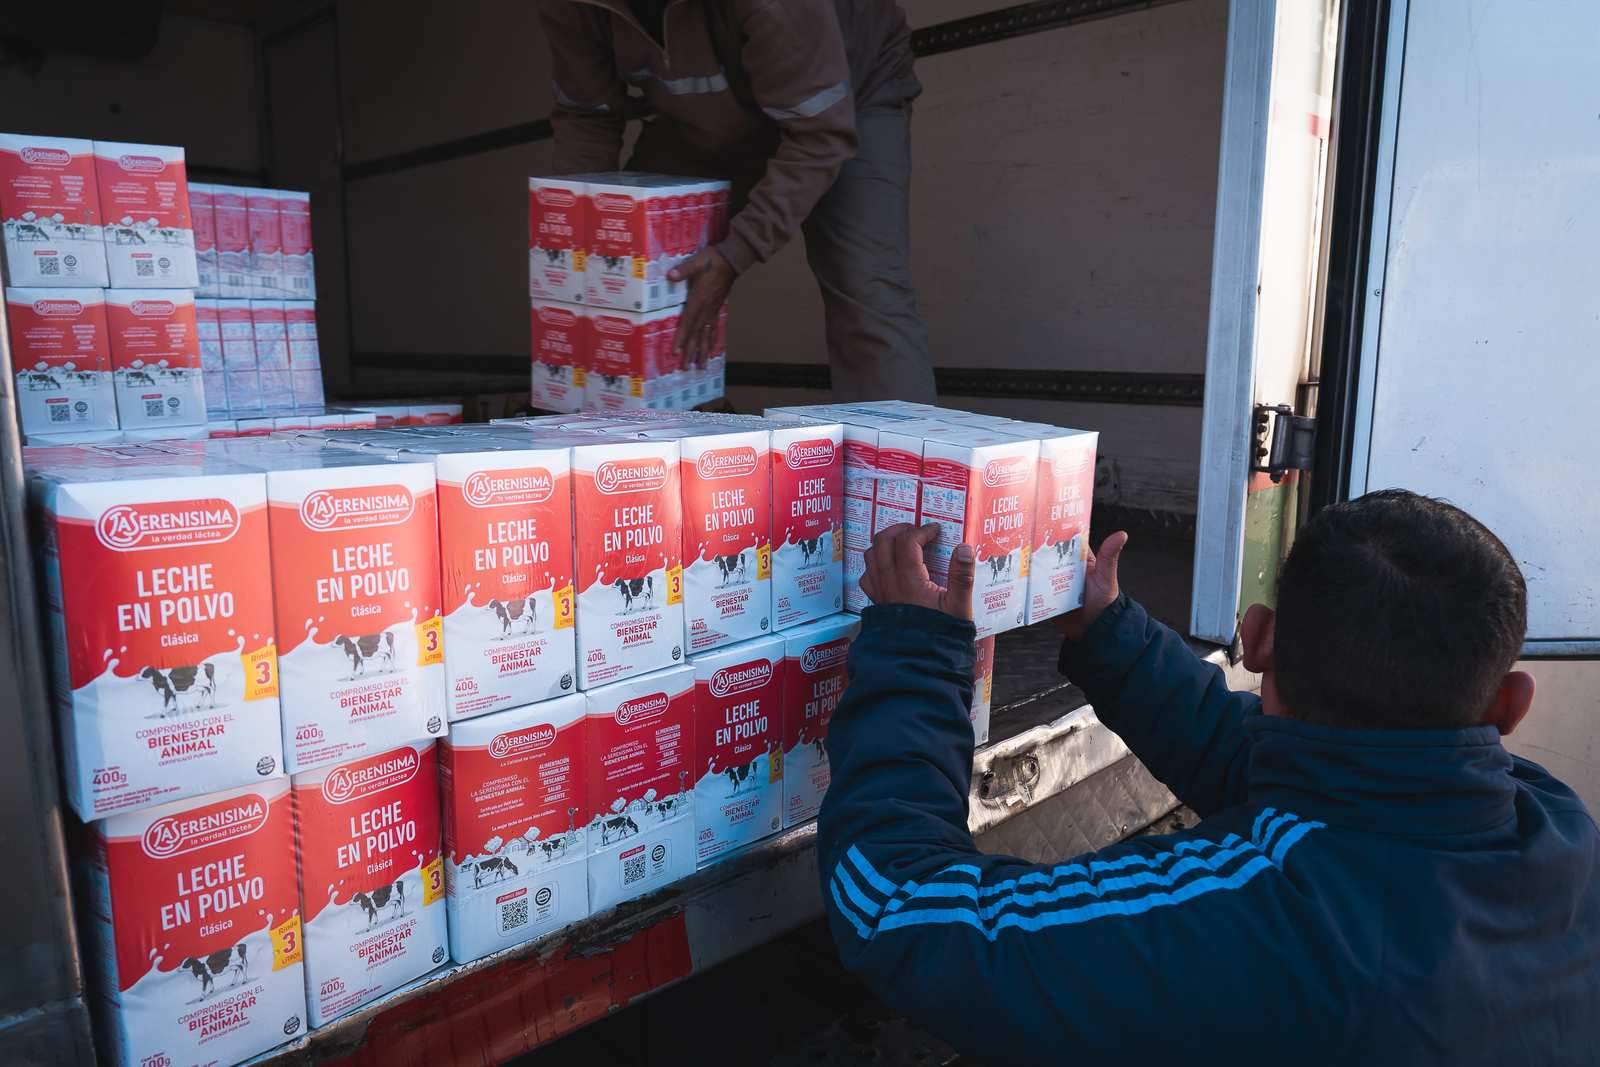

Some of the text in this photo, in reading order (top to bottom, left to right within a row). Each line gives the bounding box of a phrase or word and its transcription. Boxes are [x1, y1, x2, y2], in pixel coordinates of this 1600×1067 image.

[798, 478, 826, 497] LECHE
[712, 488, 745, 509] LECHE
[791, 495, 832, 517] EN POLVO
[993, 496, 1019, 514] LECHE
[614, 504, 653, 528] LECHE
[705, 507, 755, 532] EN POLVO
[984, 512, 1024, 534] EN POLVO
[1051, 505, 1061, 521] EN
[161, 531, 192, 542] verdad
[487, 519, 537, 544] LECHE
[604, 525, 663, 553] EN POLVO
[723, 533, 739, 542] Clásica
[332, 543, 393, 573] LECHE
[475, 541, 549, 571] EN POLVO
[625, 554, 645, 564] Clásica
[761, 553, 768, 570] 3
[136, 563, 214, 598] LECHE
[316, 568, 409, 604] EN POLVO
[502, 573, 527, 584] Clásica
[672, 577, 680, 593] 3
[351, 604, 382, 617] Clásica
[561, 598, 570, 616] 3
[715, 594, 749, 608] BIENESTAR
[721, 604, 744, 615] ANIMAL
[117, 591, 234, 632] EN POLVO
[616, 621, 657, 637] BIENESTAR
[623, 632, 651, 645] ANIMAL
[160, 632, 199, 647] Clásica
[426, 630, 438, 652] 3
[483, 642, 526, 657] COMPROMISO
[527, 639, 540, 648] CON
[491, 646, 542, 665] BIENESTAR
[500, 658, 534, 673] ANIMAL
[587, 652, 606, 663] 400g
[255, 661, 271, 685] 3
[330, 683, 383, 700] COMPROMISO
[384, 679, 400, 690] CON
[455, 680, 478, 692] 400g
[814, 675, 842, 698] LECHE
[340, 687, 403, 709] BIENESTAR
[350, 699, 395, 718] ANIMAL
[725, 700, 760, 724] LECHE
[806, 703, 818, 719] EN
[135, 713, 235, 739] COMPROMISO CON EL
[296, 728, 324, 741] 400g
[716, 716, 768, 746] EN POLVO
[148, 724, 225, 749] BIENESTAR
[160, 740, 215, 759] ANIMAL
[92, 770, 127, 786] 400g
[725, 799, 760, 817] BIENESTAR
[730, 810, 755, 823] ANIMAL
[351, 801, 402, 838] LECHE
[200, 829, 228, 844] verdad
[337, 820, 416, 869] EN POLVO
[177, 854, 246, 897] LECHE
[367, 858, 393, 875] Clásica
[430, 870, 441, 890] 3
[161, 877, 264, 930] EN POLVO
[200, 919, 233, 937] Clásica
[350, 918, 417, 953] COMPROMISO CON EL
[282, 931, 296, 953] 3
[358, 928, 412, 959] BIENESTAR
[367, 942, 405, 965] ANIMAL
[320, 981, 345, 997] 400g
[177, 984, 265, 1025] COMPROMISO CON EL
[188, 996, 257, 1031] BIENESTAR
[200, 1011, 248, 1038] ANIMAL
